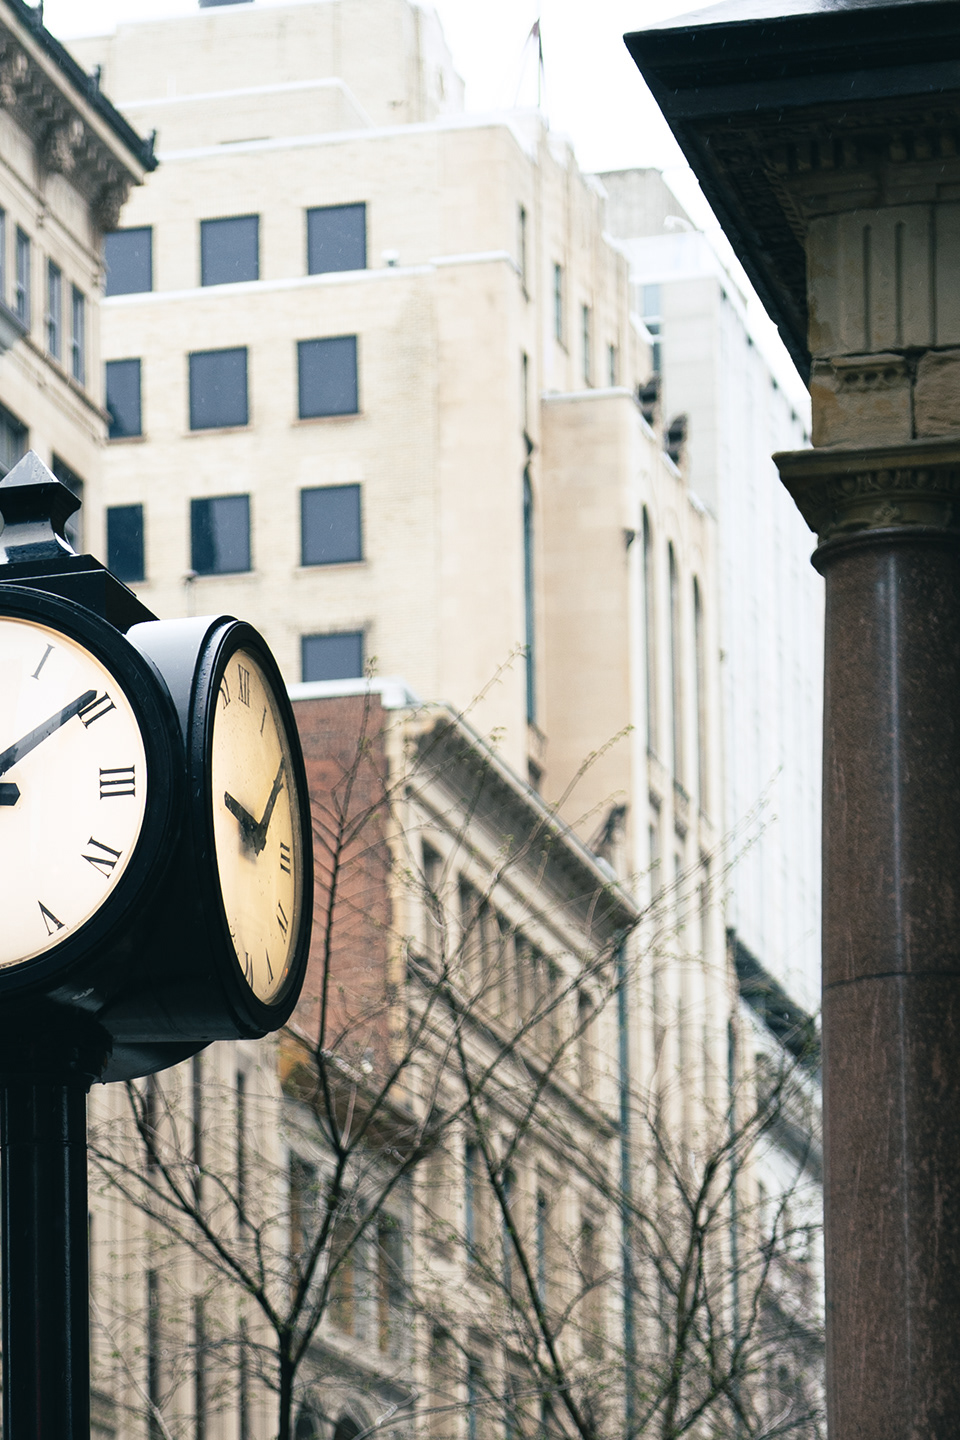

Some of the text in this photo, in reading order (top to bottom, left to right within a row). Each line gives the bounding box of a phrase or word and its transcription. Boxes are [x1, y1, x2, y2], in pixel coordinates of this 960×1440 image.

[31, 643, 55, 680] I
[238, 664, 250, 708] XII
[76, 691, 117, 729] II
[259, 704, 267, 737] I
[99, 764, 136, 800] III
[81, 836, 122, 879] IV
[280, 842, 291, 876] III
[38, 900, 65, 936] V
